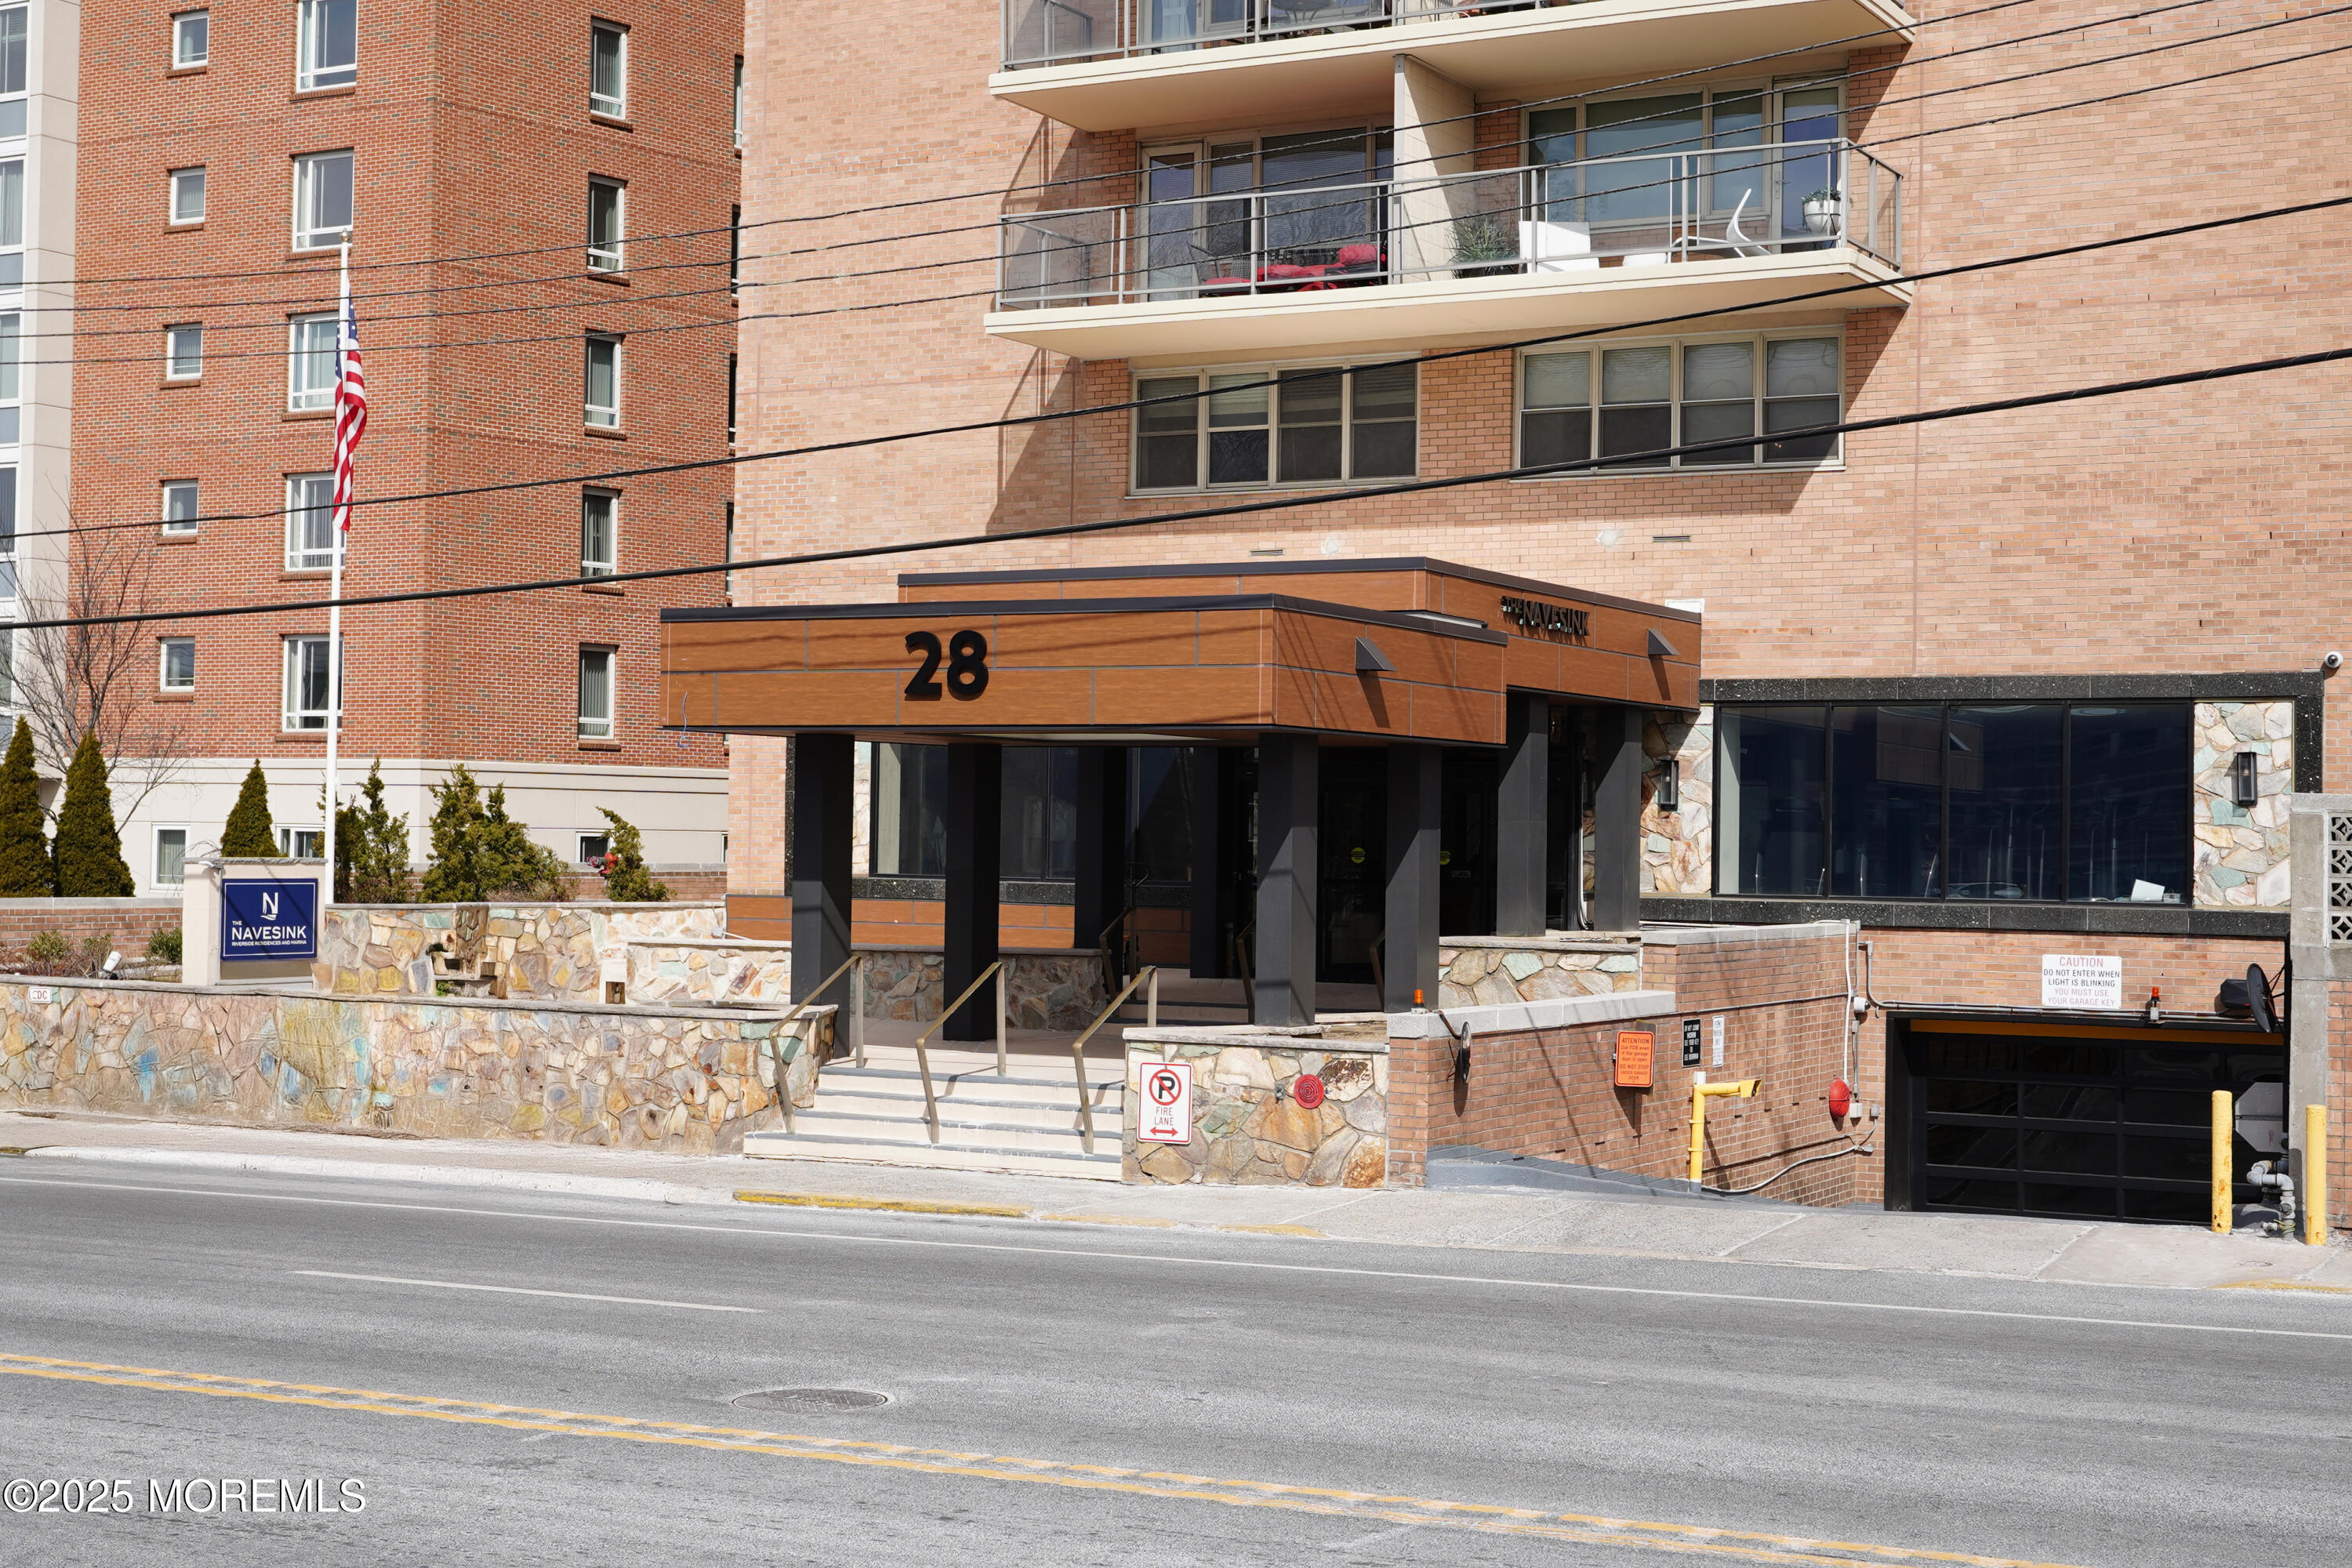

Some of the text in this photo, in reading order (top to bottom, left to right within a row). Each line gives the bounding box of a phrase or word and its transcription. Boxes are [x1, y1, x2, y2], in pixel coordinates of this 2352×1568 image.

[1523, 601, 1591, 637] NAVESINK
[904, 630, 989, 702] 28
[232, 926, 307, 940] NAVESINK
[2060, 956, 2103, 967] CAUTION
[2072, 969, 2096, 978] ENTER
[2098, 970, 2120, 978] WHEN
[2048, 978, 2069, 986] LIGHT
[2081, 978, 2115, 988] BLINKING
[2048, 996, 2067, 1005] YOUR
[2070, 997, 2100, 1006] GARAGE
[1156, 1106, 1174, 1116] FIRE
[1154, 1116, 1174, 1126] LANE
